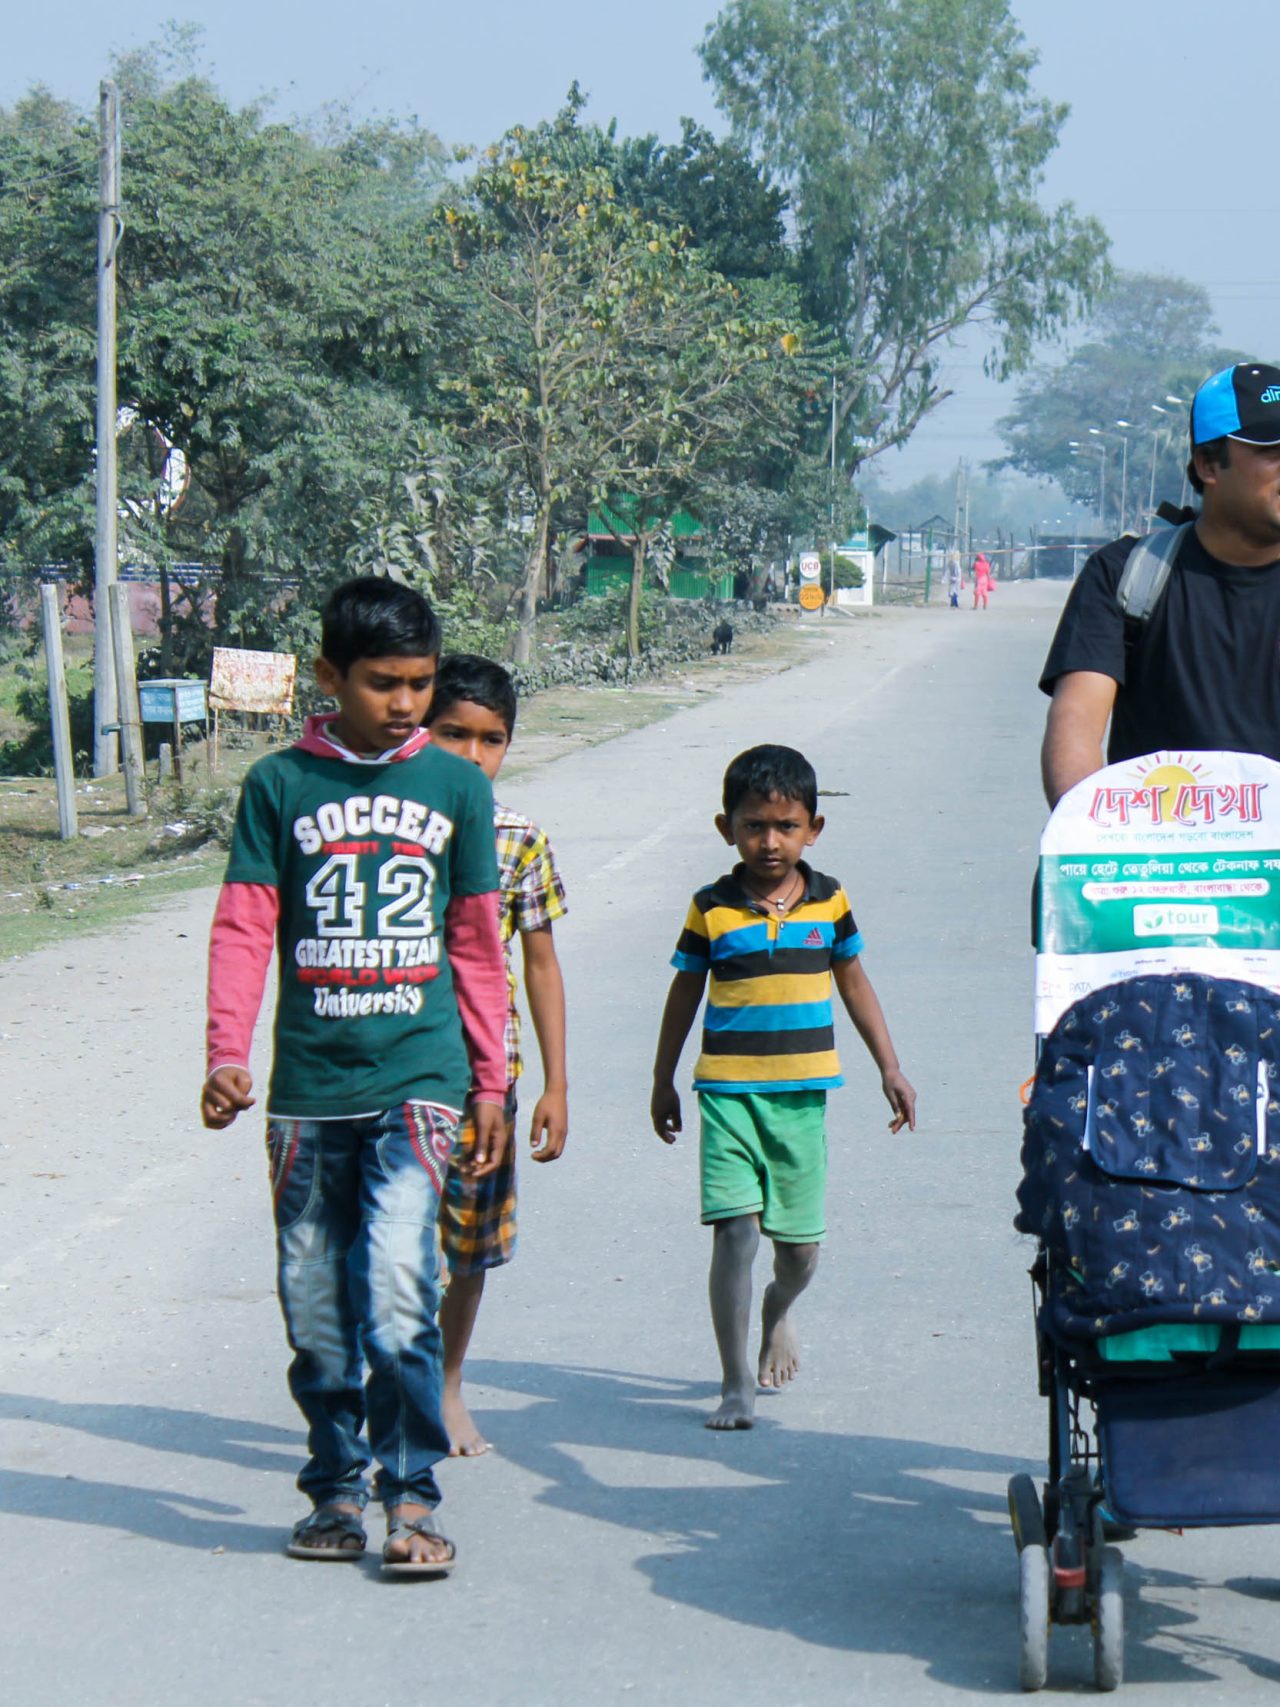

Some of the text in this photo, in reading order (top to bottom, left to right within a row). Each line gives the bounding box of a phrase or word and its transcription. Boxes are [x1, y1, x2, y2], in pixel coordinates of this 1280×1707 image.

[1088, 783, 1267, 827] দেশ দেখা
[294, 795, 453, 855] SOCCER
[1178, 862, 1209, 875] থেকে
[305, 854, 437, 937] 42
[1167, 909, 1209, 925] tour
[295, 938, 394, 968] GREATEST
[313, 983, 422, 1018] University
